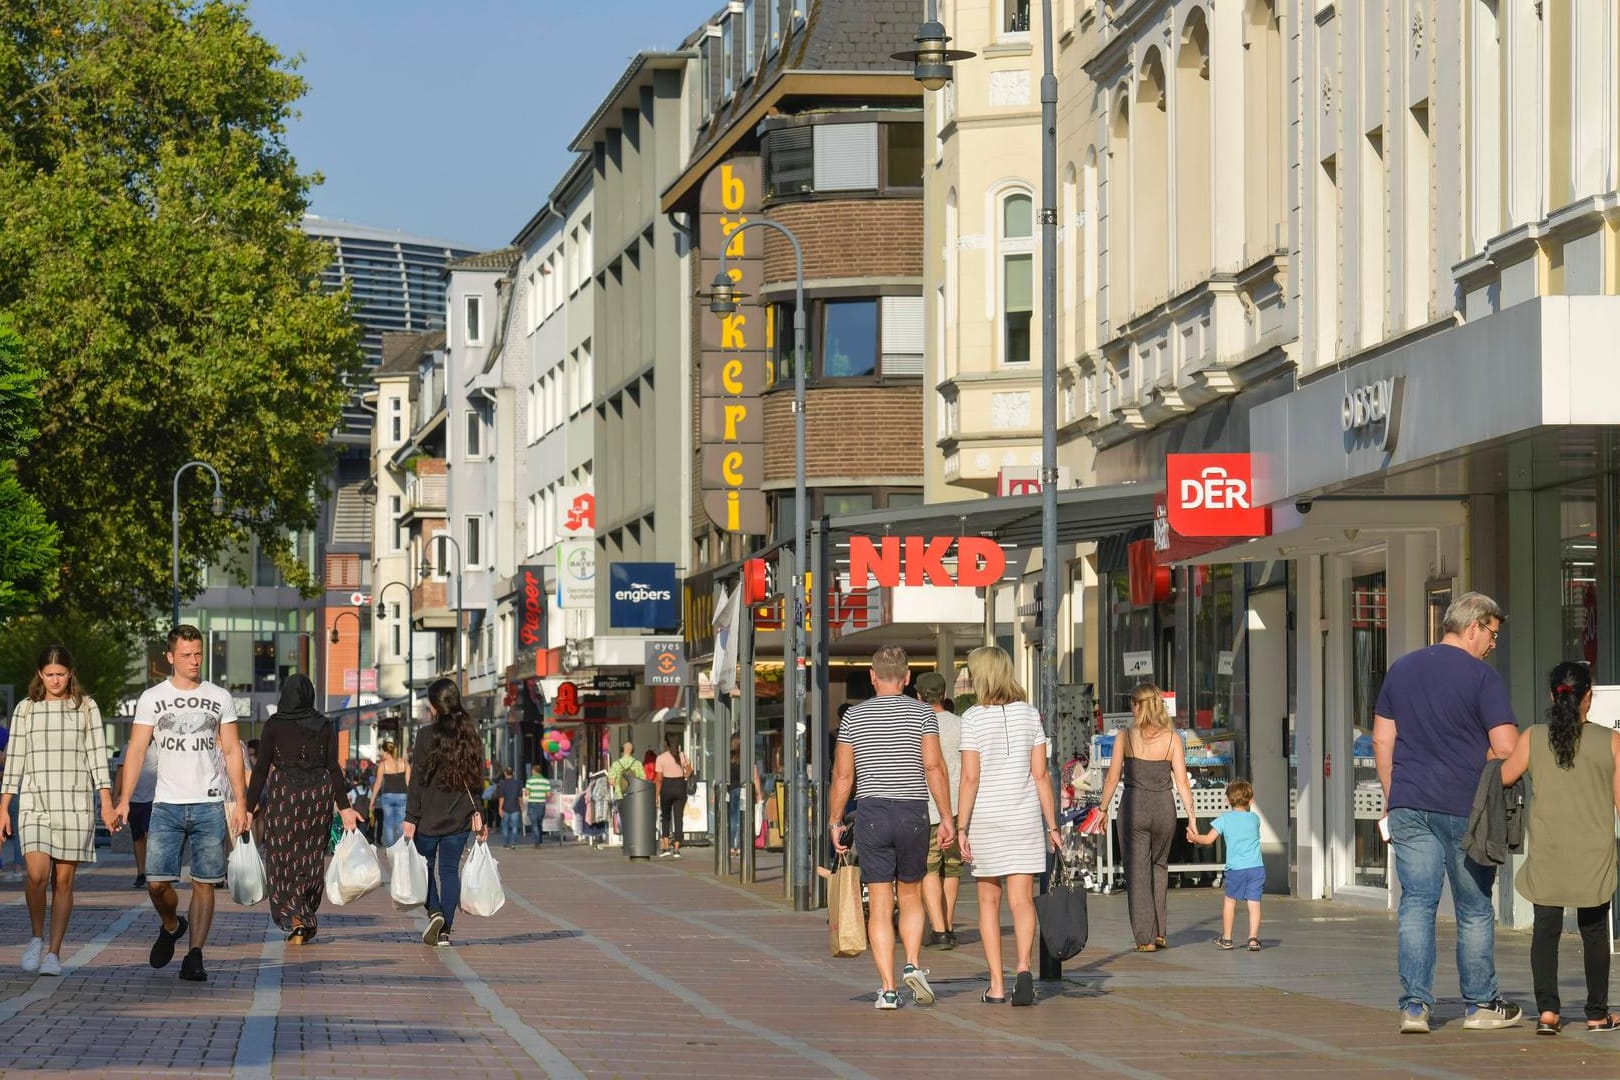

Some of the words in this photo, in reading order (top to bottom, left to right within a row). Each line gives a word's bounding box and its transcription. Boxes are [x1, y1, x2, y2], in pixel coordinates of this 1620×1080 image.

[1180, 466, 1250, 509] DER
[849, 536, 1007, 587] NKD
[615, 588, 671, 603] engbers
[521, 570, 542, 645] Pieper
[654, 643, 681, 652] eyes
[598, 679, 631, 688] engbers
[154, 697, 222, 714] JI-CORE
[160, 737, 186, 751] JCK
[192, 737, 214, 751] JNS
